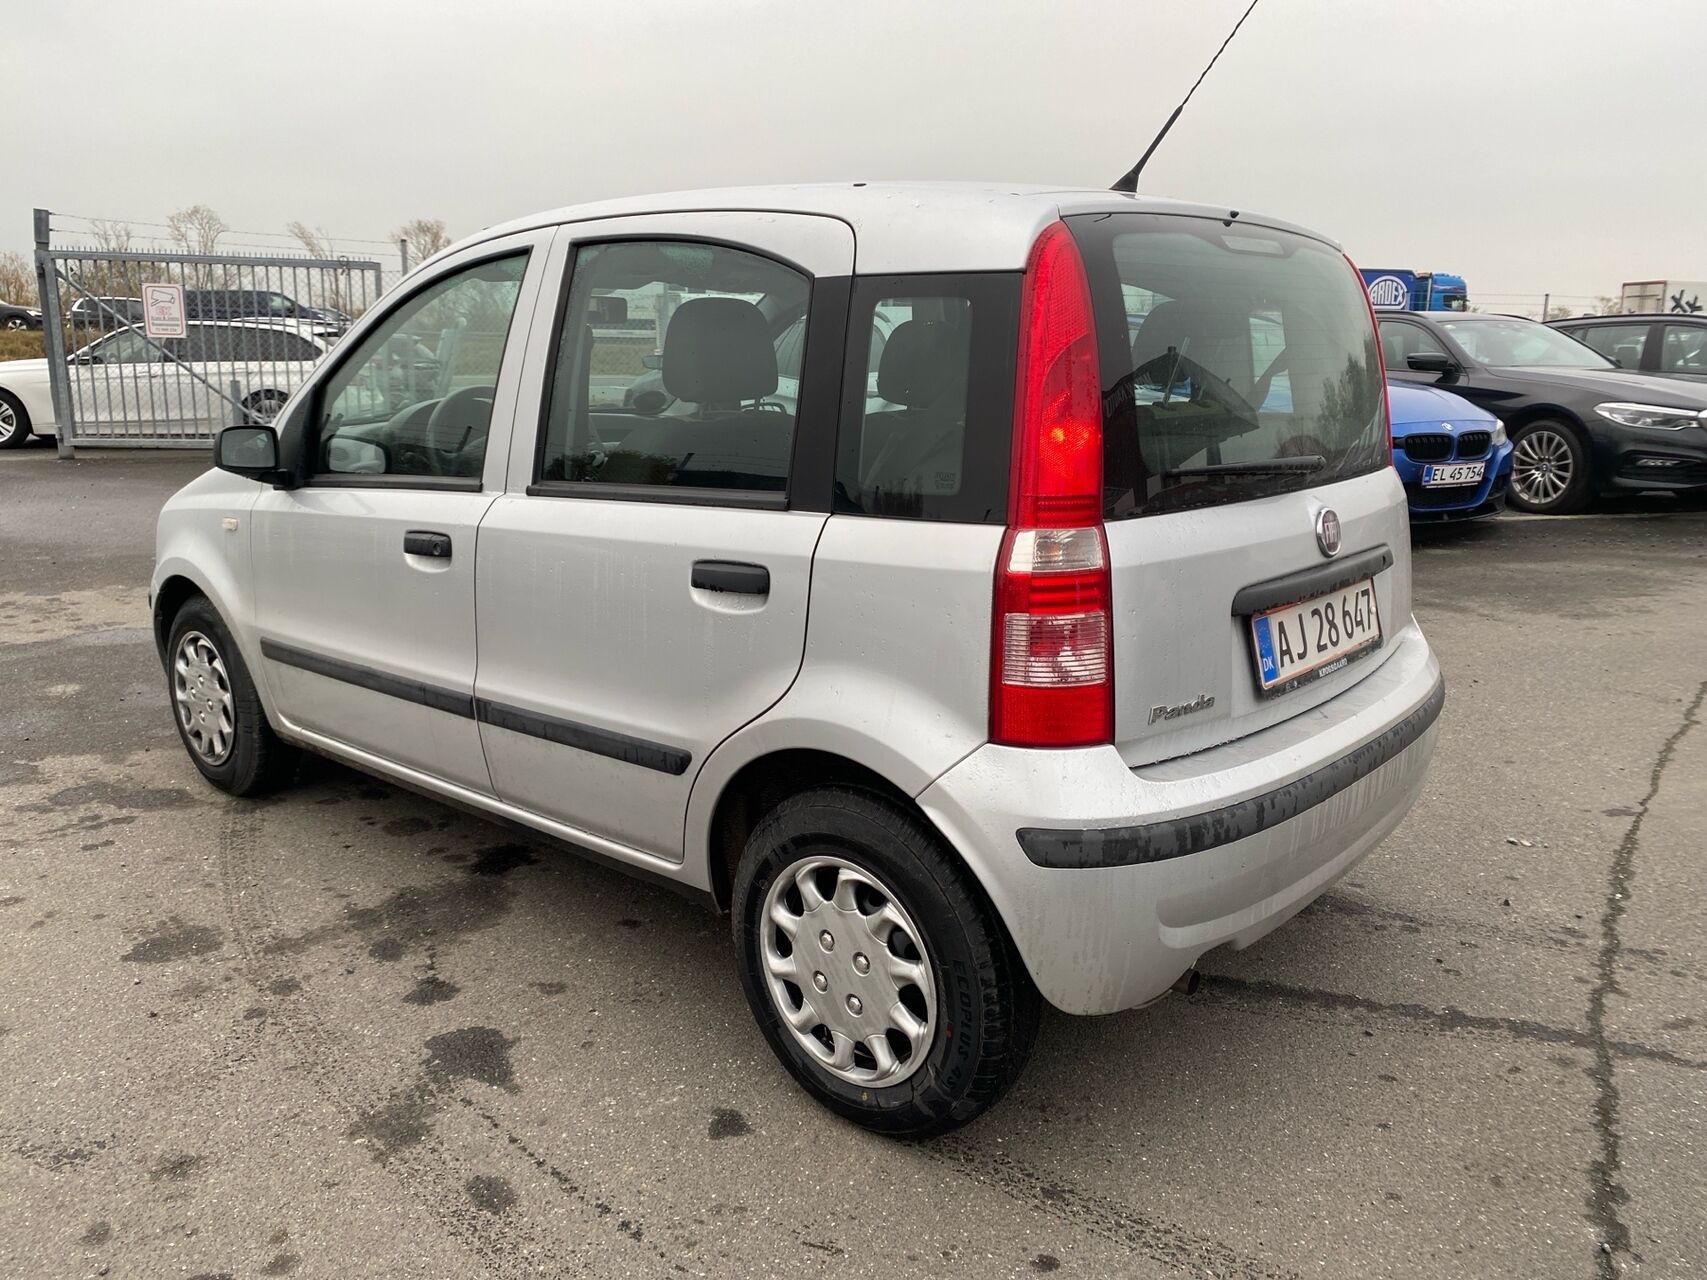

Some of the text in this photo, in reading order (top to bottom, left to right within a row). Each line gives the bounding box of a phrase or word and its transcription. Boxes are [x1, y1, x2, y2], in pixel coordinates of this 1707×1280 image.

[1371, 280, 1404, 305] ARDEX
[1432, 468, 1446, 481] EL
[1277, 588, 1371, 667] AJ 28 647
[1262, 656, 1274, 671] DK
[1147, 694, 1215, 726] Panda
